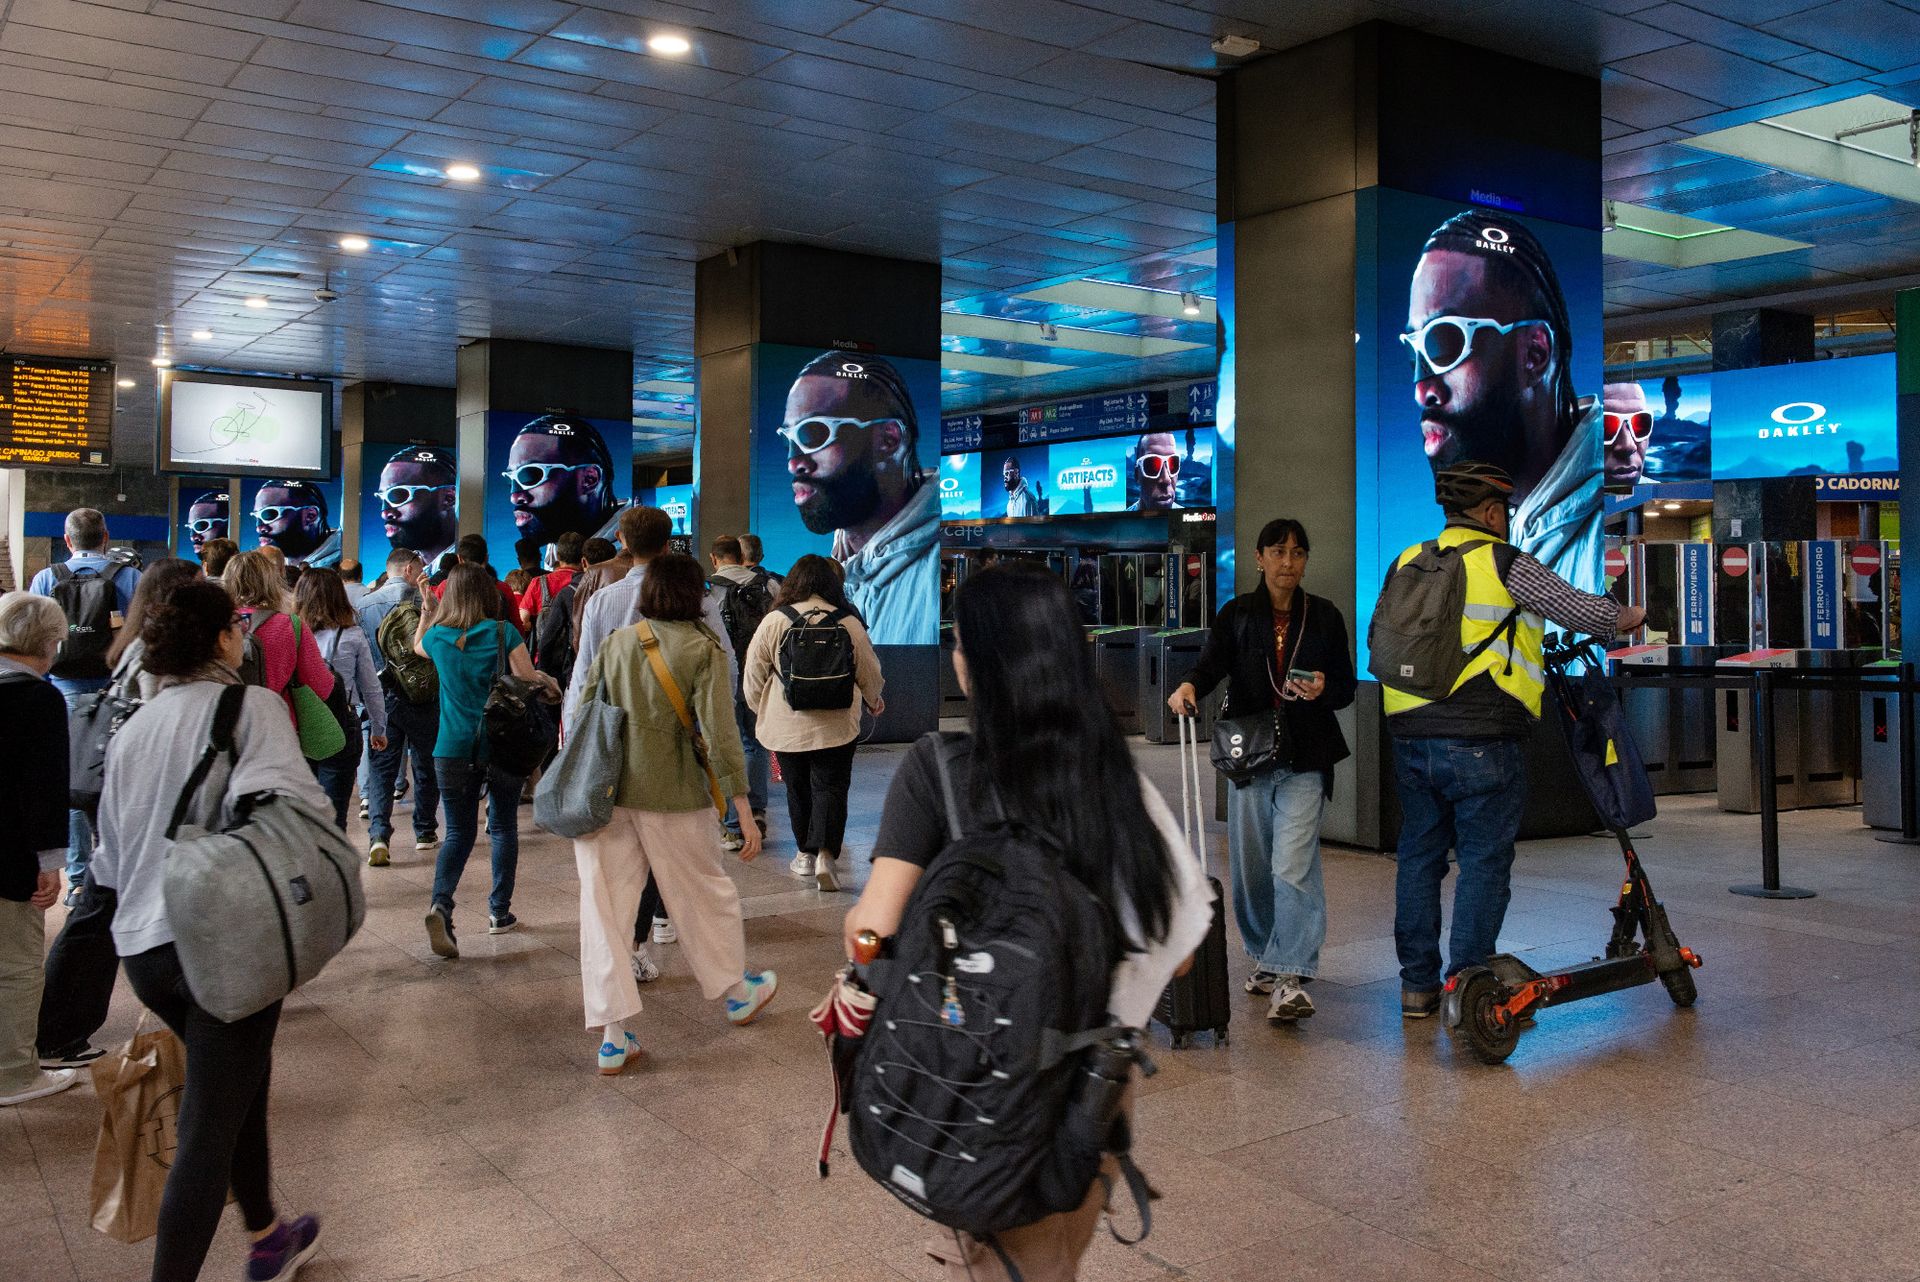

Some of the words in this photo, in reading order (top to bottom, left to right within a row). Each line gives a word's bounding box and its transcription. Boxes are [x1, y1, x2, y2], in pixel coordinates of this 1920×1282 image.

[1470, 188, 1502, 206] Media
[1475, 239, 1516, 254] OAKLEY
[832, 339, 858, 349] Media
[836, 371, 868, 379] OAKLEY
[1030, 410, 1042, 420] M1
[1046, 408, 1057, 419] M2
[1758, 423, 1839, 439] OAKLEY
[1061, 468, 1114, 485] ARTIFACTS
[1690, 549, 1698, 618] FERROVIENORD
[1815, 546, 1825, 620] FERROVIENORD
